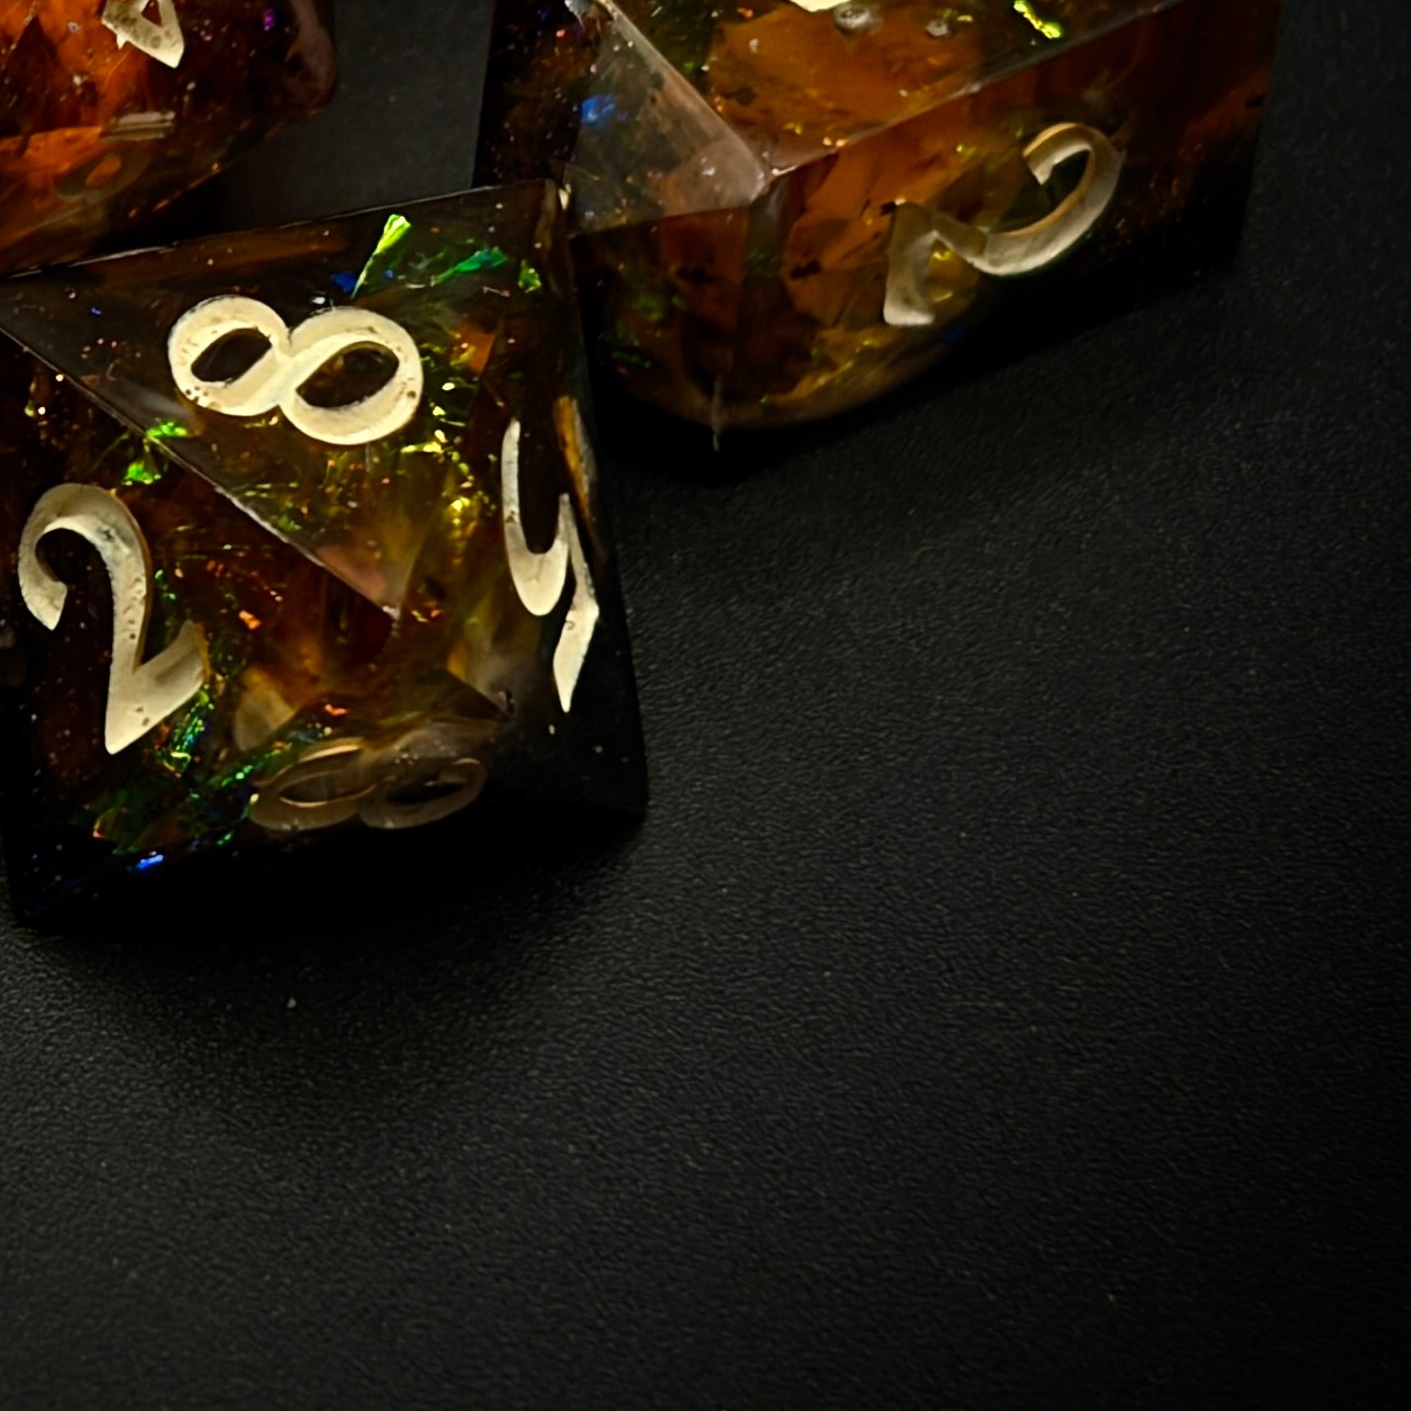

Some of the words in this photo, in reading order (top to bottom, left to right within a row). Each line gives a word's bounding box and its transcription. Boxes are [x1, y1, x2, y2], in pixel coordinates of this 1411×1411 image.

[881, 121, 1126, 327] 2
[168, 295, 424, 446] 8
[18, 483, 208, 755] 2
